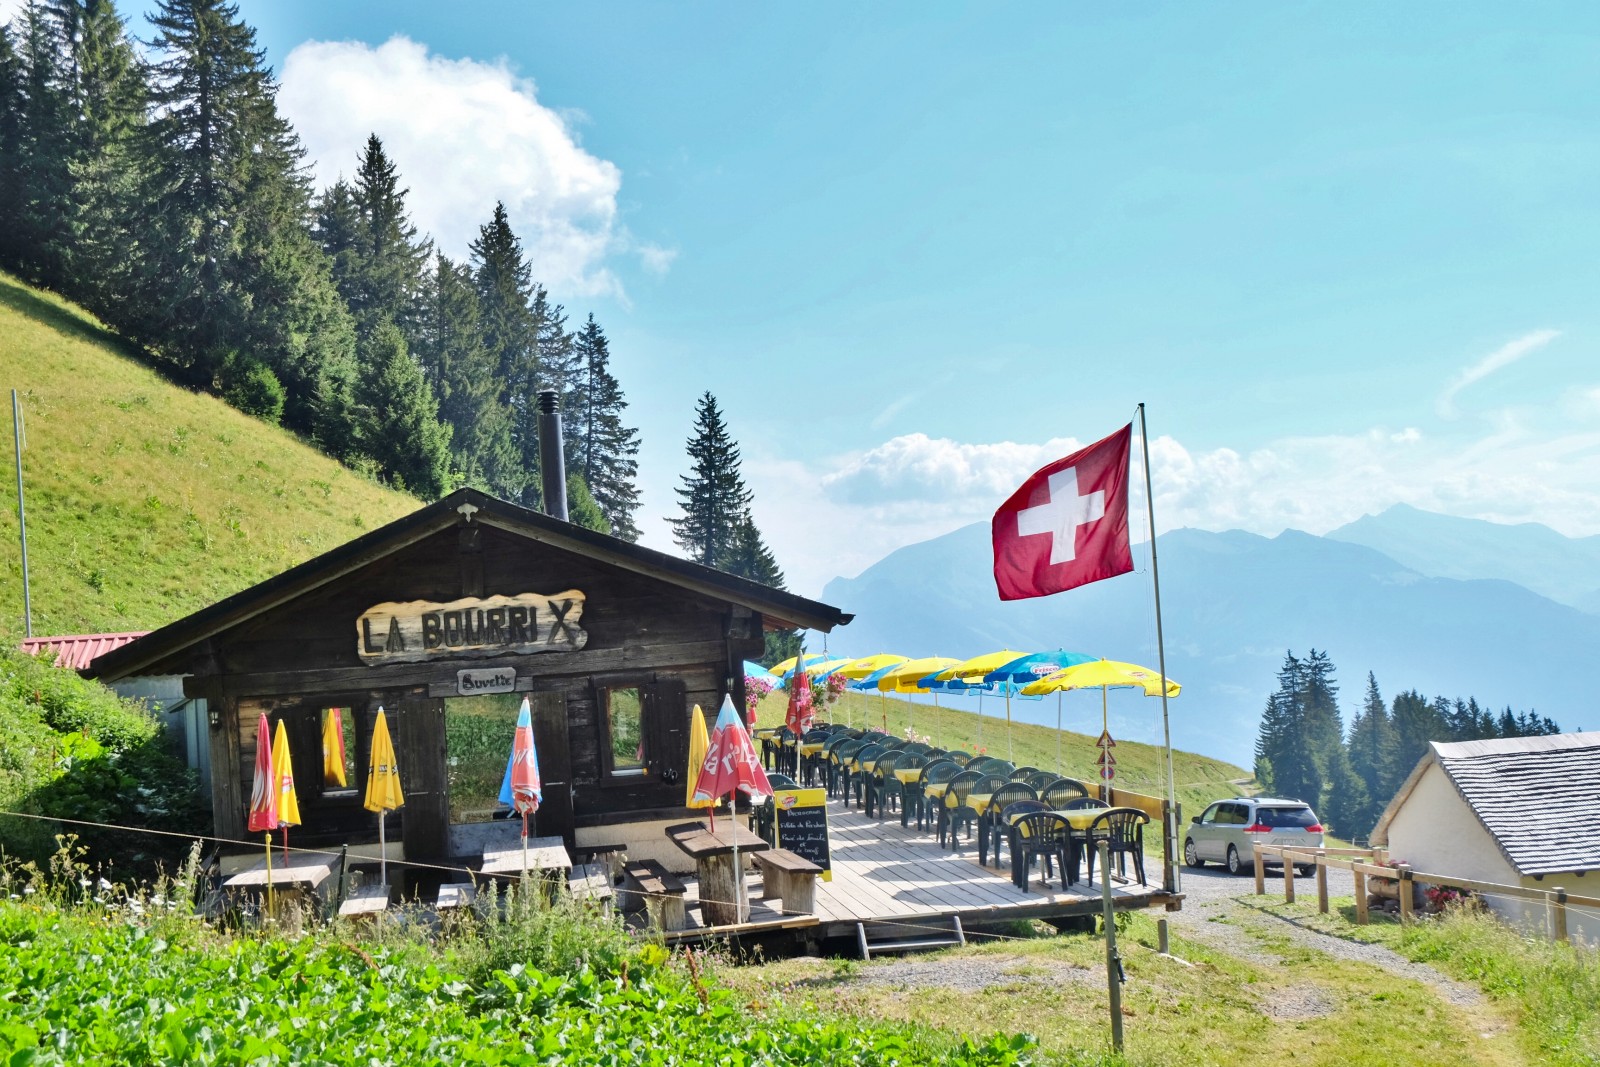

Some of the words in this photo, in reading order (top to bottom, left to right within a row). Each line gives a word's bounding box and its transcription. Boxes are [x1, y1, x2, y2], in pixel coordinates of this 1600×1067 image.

[363, 616, 404, 653] LA
[1034, 665, 1058, 673] Frisco
[462, 673, 512, 690] Buvette
